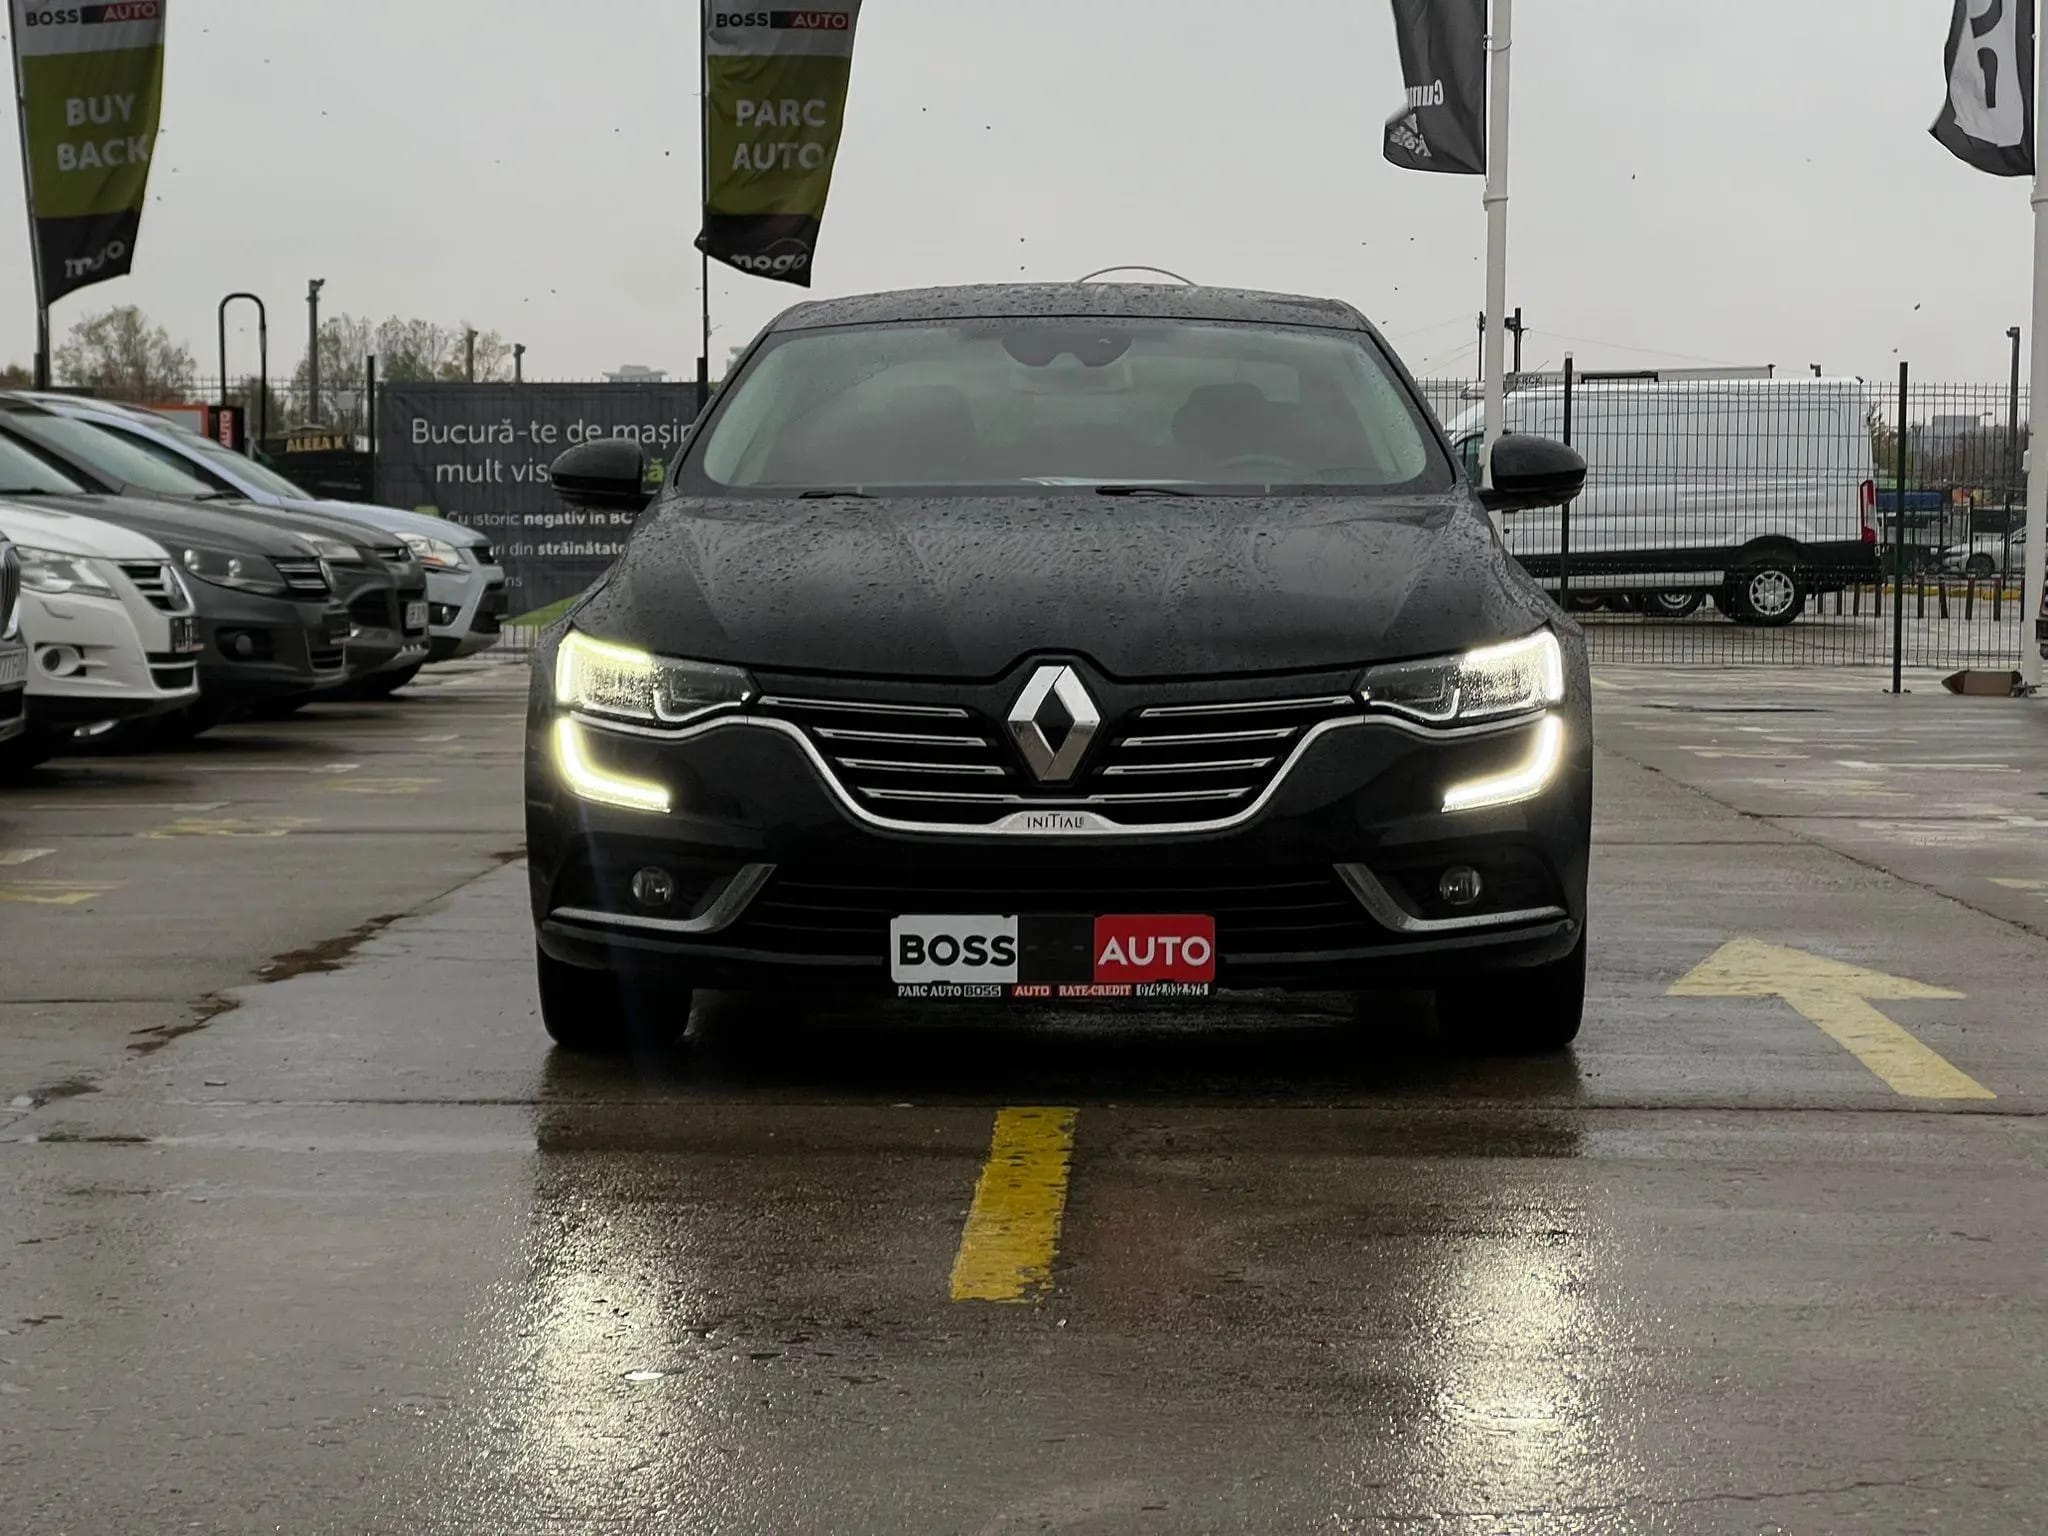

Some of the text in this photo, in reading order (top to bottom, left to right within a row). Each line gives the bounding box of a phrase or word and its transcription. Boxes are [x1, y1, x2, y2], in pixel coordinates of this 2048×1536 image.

[26, 2, 157, 26] BOSS AUTO
[716, 13, 846, 28] BOSS AUTO
[65, 94, 135, 126] BUY
[735, 100, 827, 127] PARC
[57, 134, 149, 172] BACK
[732, 143, 825, 170] AUTO
[411, 418, 557, 444] Bucură-te
[566, 418, 602, 443] de
[436, 459, 552, 483] mult vis
[473, 512, 521, 526] istoric
[524, 512, 586, 528] negativ
[509, 542, 533, 556] din
[899, 934, 1212, 967] BOSS AUTO
[898, 985, 928, 997] PARC
[929, 985, 962, 997] AUTO
[963, 985, 1001, 997] BOSS
[1014, 985, 1050, 997] AUTO
